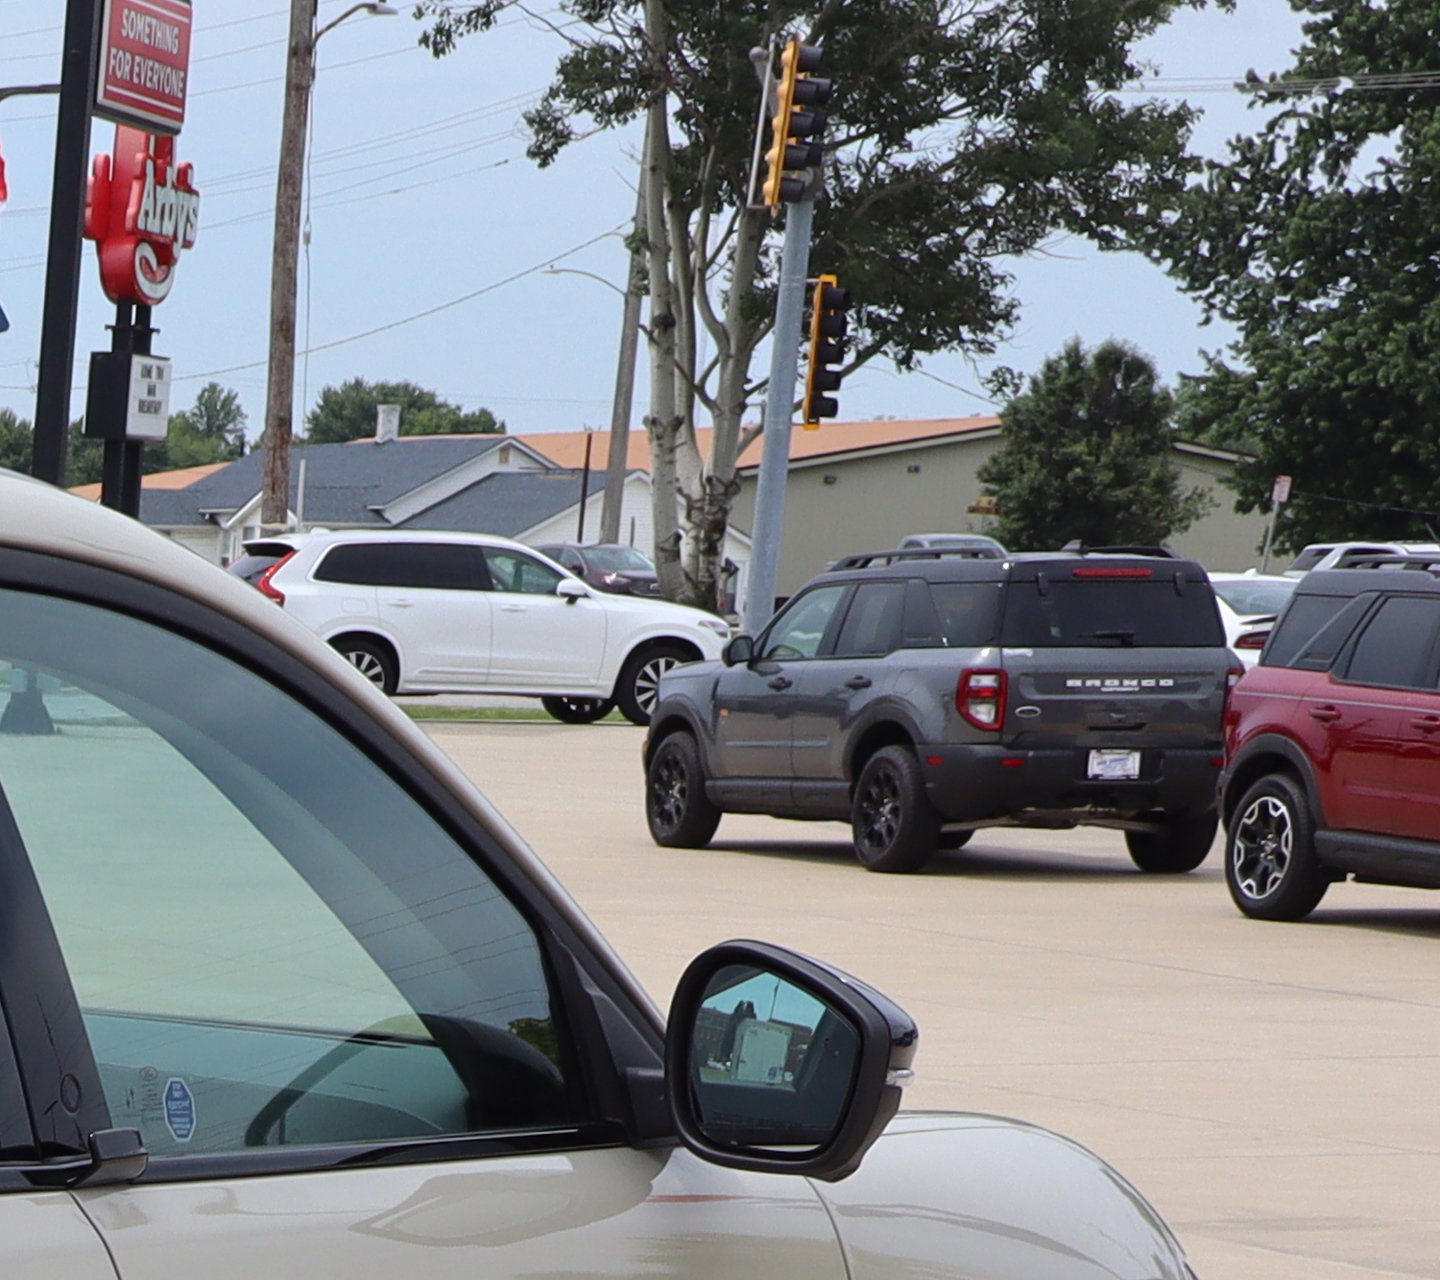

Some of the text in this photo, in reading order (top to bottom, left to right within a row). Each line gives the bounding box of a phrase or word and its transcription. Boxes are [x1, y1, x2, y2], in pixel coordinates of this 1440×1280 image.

[121, 8, 179, 55] SOMETHING
[109, 47, 184, 99] FOR EVERYONE
[137, 158, 199, 259] Arby's
